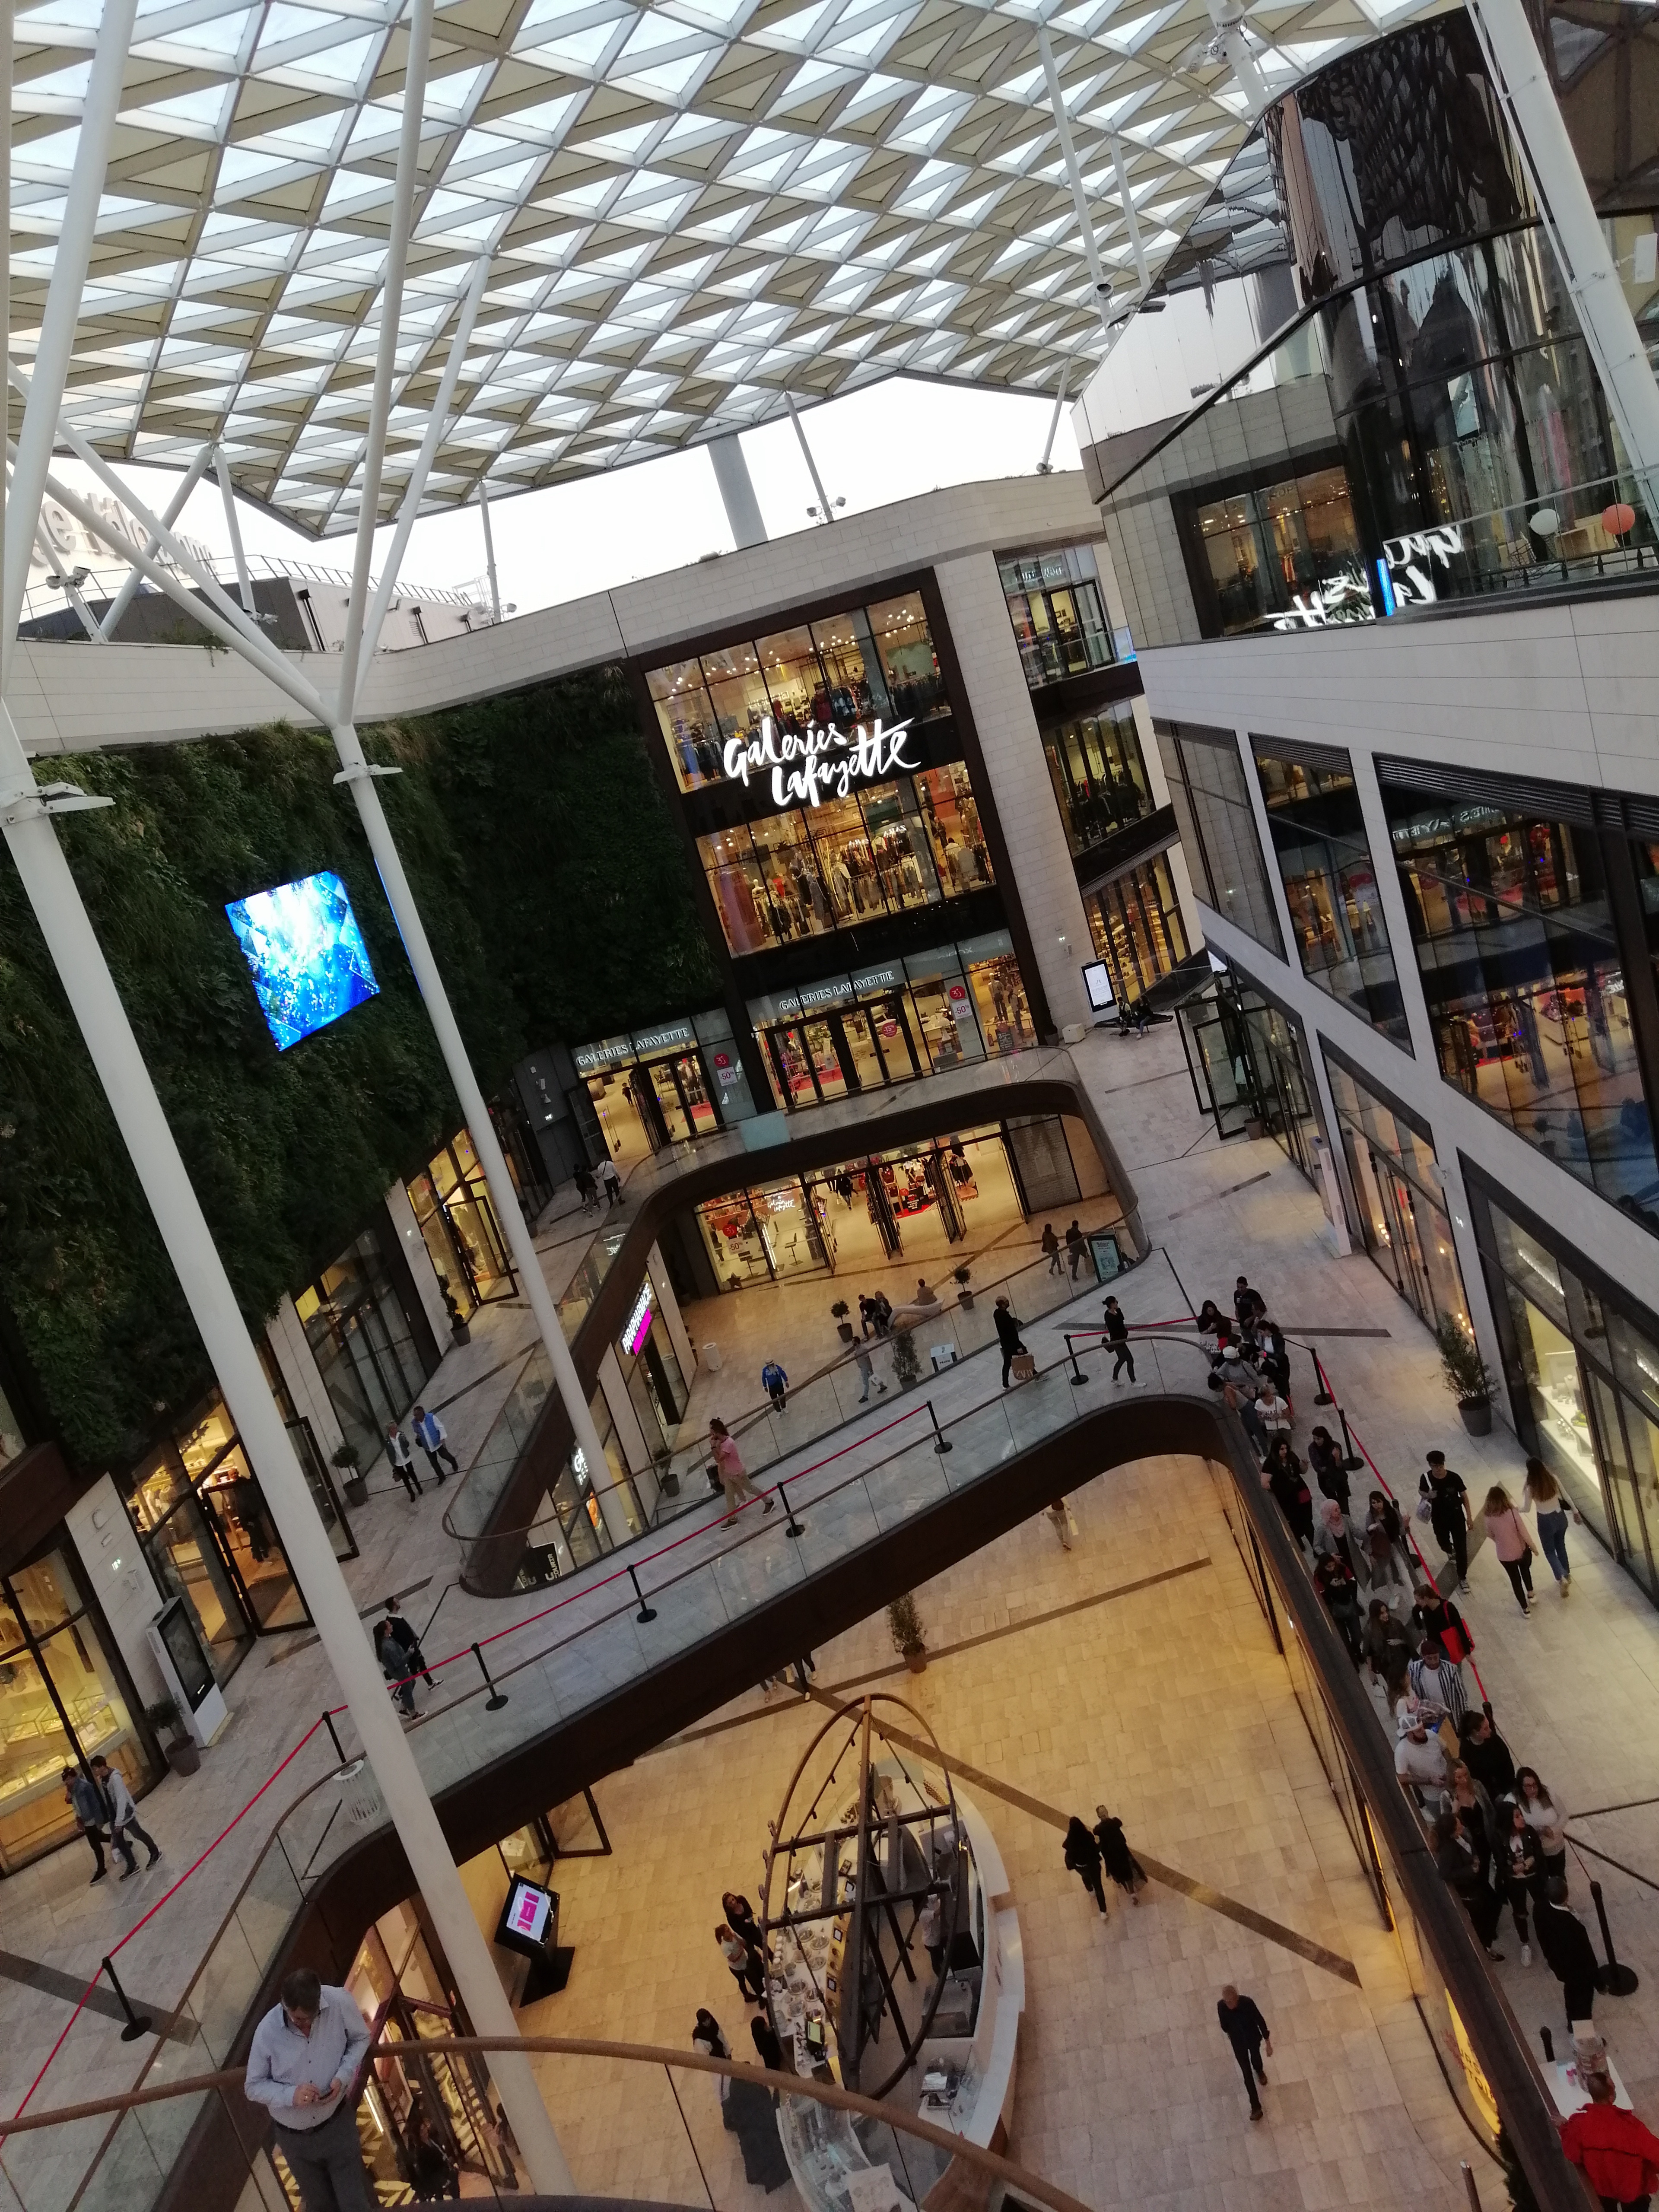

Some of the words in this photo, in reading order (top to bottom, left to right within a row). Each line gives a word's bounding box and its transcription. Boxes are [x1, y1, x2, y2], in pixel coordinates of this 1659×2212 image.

[723, 716, 848, 787] Galeries
[772, 717, 921, 807] Lafayette
[779, 988, 833, 1011] GALERIES
[833, 971, 894, 996] LAFAYETTE
[576, 1044, 628, 1066] GALERIES
[630, 1027, 690, 1052] LAFAYETTE
[622, 1282, 652, 1355] PARAPHARMACIE
